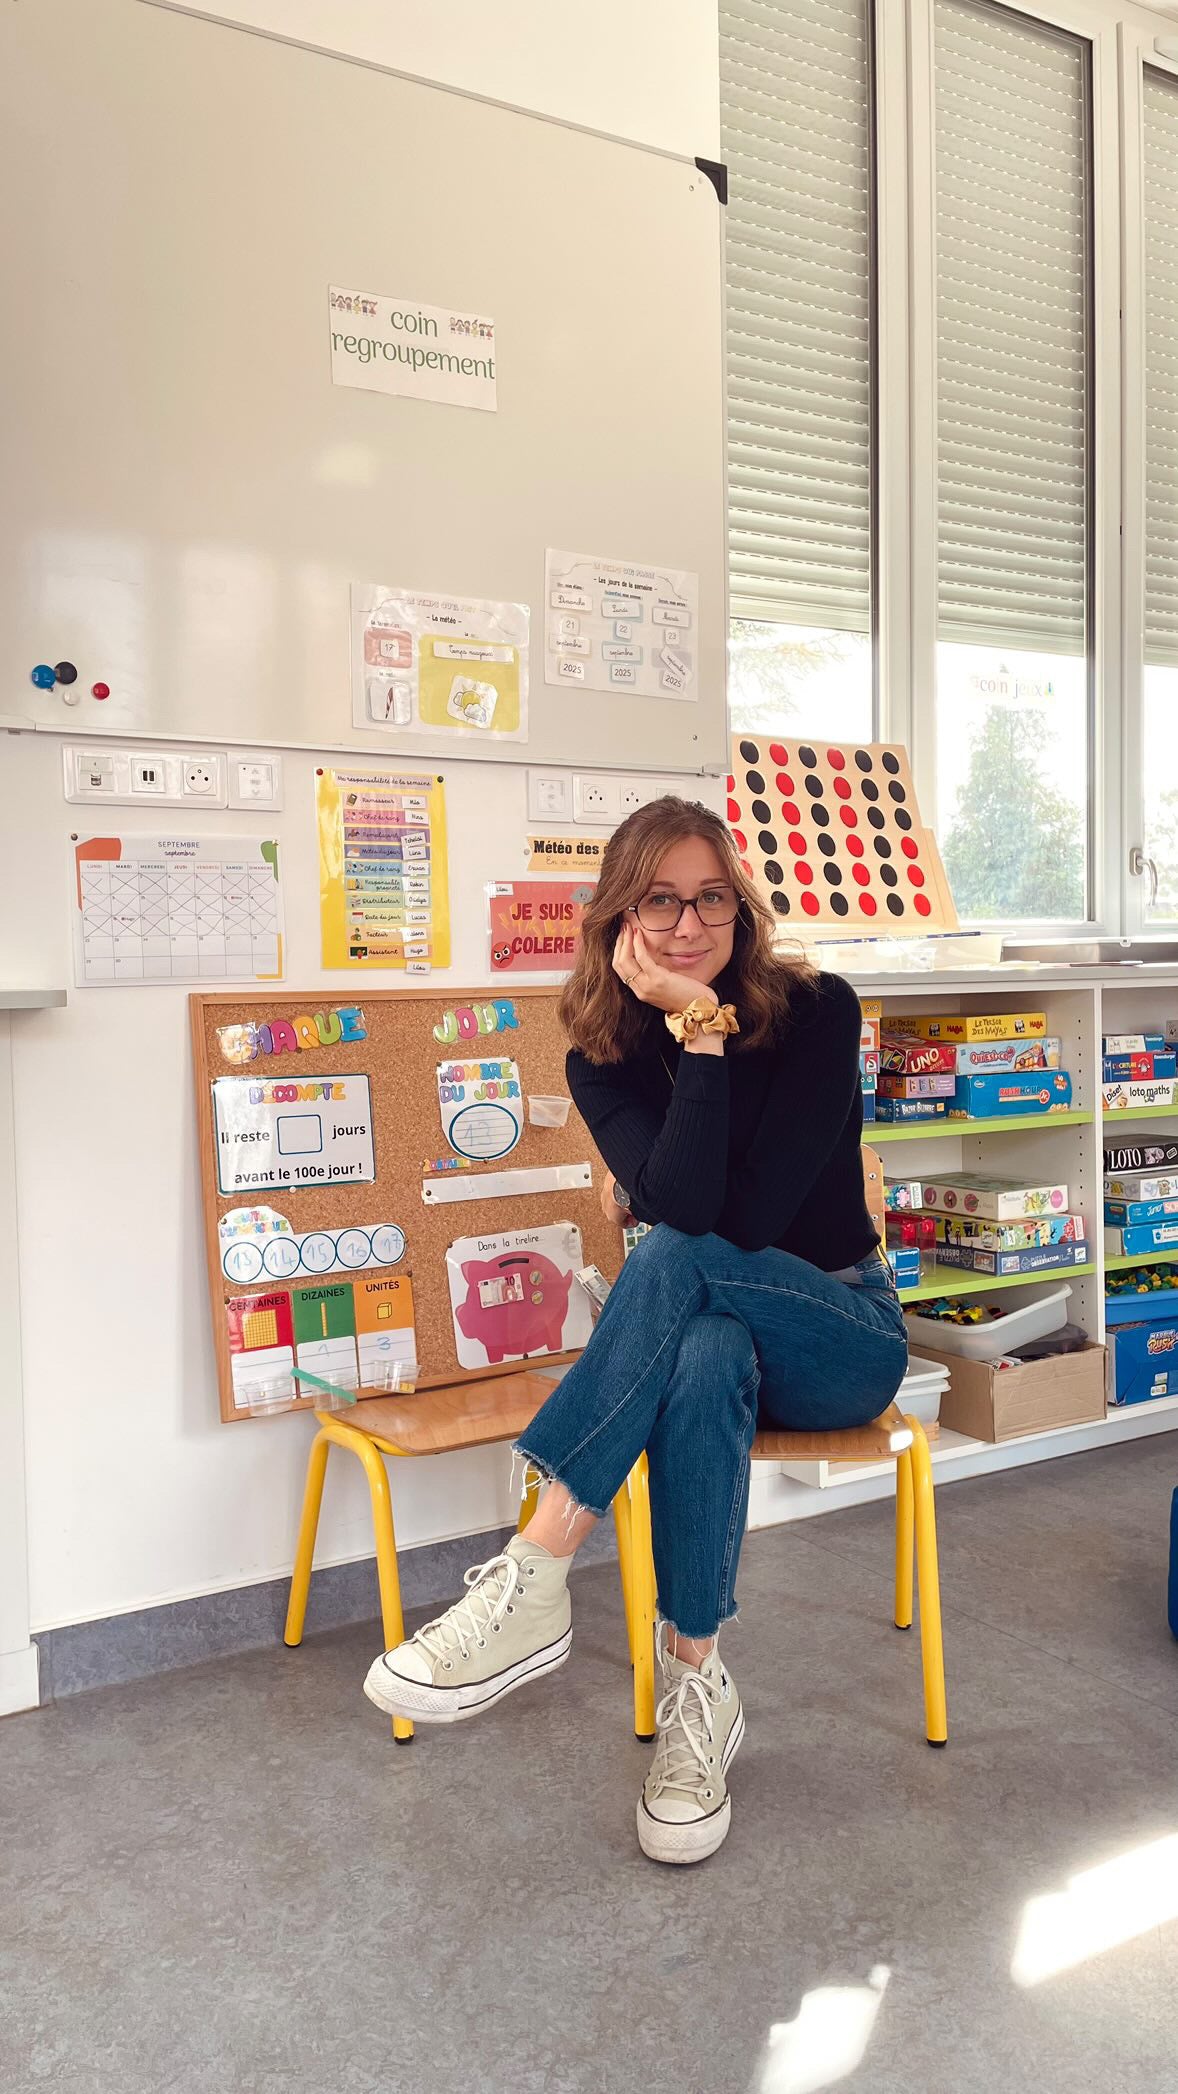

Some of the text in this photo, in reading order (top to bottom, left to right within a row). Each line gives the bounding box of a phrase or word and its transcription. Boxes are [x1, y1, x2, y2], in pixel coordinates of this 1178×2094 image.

[391, 311, 438, 337] coin
[332, 332, 495, 379] regroupement
[598, 576, 606, 584] Les
[607, 578, 620, 586] jours
[634, 583, 653, 591] semaine
[432, 614, 438, 622] La
[440, 616, 456, 625] météo
[566, 619, 575, 629] 21
[619, 625, 628, 633] 22
[668, 632, 677, 640] 23
[563, 663, 582, 675] 2025
[614, 668, 632, 678] 2025
[665, 675, 682, 688] 2025
[158, 841, 200, 849] SEPTEMBRE
[533, 840, 572, 855] Météo
[576, 842, 600, 855] des
[511, 903, 574, 921] JE SUIS
[512, 936, 575, 954] COLERE
[433, 999, 519, 1044] JOUR
[1030, 1021, 1043, 1029] HABA
[947, 1025, 963, 1034] HABA
[972, 1027, 984, 1035] DES
[910, 1048, 939, 1073] UNO
[440, 1062, 513, 1084] NOMBRE
[439, 1081, 520, 1104] DU JOUR
[1130, 1087, 1145, 1097] loto
[1146, 1085, 1170, 1097] maths
[234, 1131, 270, 1143] reste
[332, 1124, 366, 1139] jours
[1111, 1148, 1141, 1169] LOTO
[234, 1168, 275, 1184] avant
[278, 1168, 290, 1180] le
[294, 1166, 325, 1179] 100e
[327, 1163, 355, 1180] jour
[478, 1240, 497, 1251] Dans
[502, 1237, 510, 1248] la
[307, 1243, 327, 1263] 15
[505, 1276, 515, 1286] 10
[228, 1280, 400, 1312] CENTAINES DIZAINES UNITÉS
[377, 1337, 391, 1350] 3
[1149, 1339, 1174, 1353] RUSH
